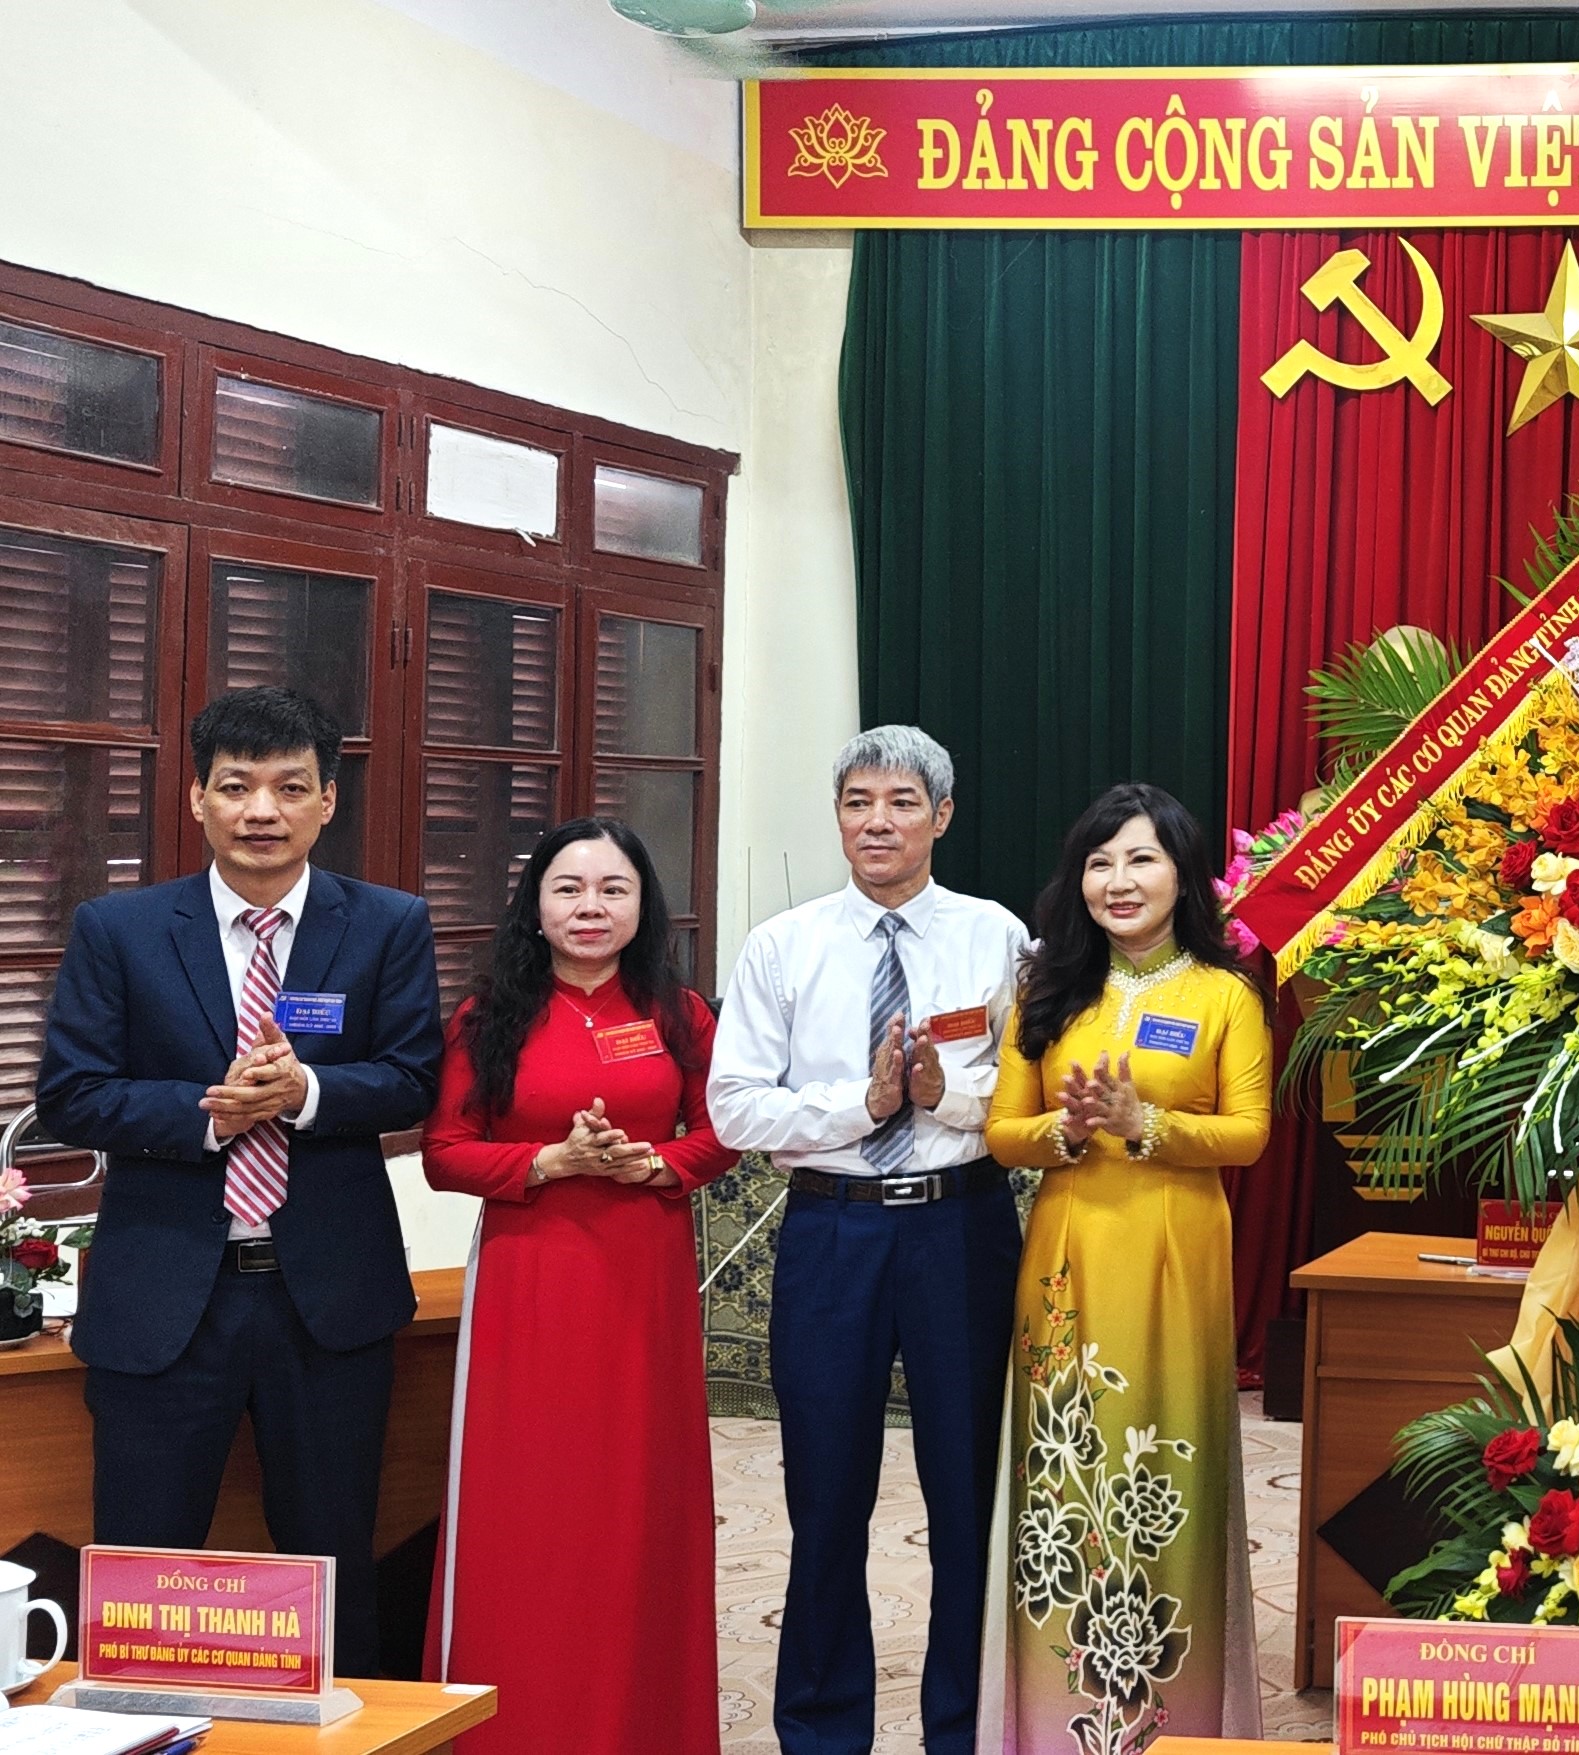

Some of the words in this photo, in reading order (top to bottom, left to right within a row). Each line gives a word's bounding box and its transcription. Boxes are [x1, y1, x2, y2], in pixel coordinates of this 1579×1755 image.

[917, 88, 1099, 192] ĐẢNG
[1115, 94, 1292, 210] CỘNG
[1309, 84, 1439, 191] SẢN
[1294, 828, 1355, 891] ĐẢNG
[1349, 796, 1383, 837] ỦY
[1376, 765, 1418, 806] CÁC
[1411, 735, 1442, 775] CƠ
[1437, 693, 1493, 750] QUAN
[1484, 640, 1541, 700] ĐẢNG
[1485, 1221, 1529, 1242] NGUYỄN
[1531, 1225, 1553, 1244] QUỐ
[157, 1569, 209, 1592] ĐỒNG
[214, 1574, 247, 1594] CHÍ
[102, 1601, 153, 1631] ĐINH
[159, 1604, 191, 1638] THỊ
[197, 1606, 266, 1637] THANH
[271, 1606, 301, 1639] HÀ
[99, 1641, 117, 1659] PHÓ
[119, 1643, 129, 1660] BÍ
[131, 1645, 150, 1661] THƯ
[151, 1641, 175, 1662] ĐẢNG
[177, 1642, 189, 1663] ỦY
[191, 1646, 209, 1664] CÁC
[212, 1649, 224, 1665] CƠ
[226, 1652, 251, 1667] QUAN
[252, 1647, 277, 1668] ĐẢNG
[280, 1649, 301, 1669] TỈNH
[1420, 1638, 1487, 1663] ĐỒNG
[1494, 1641, 1536, 1665] CHÍ
[1362, 1676, 1434, 1728] PHẠM
[1443, 1673, 1510, 1722] HÙNG
[1361, 1730, 1387, 1745] PHÓ
[1390, 1730, 1416, 1748] CHỦ
[1420, 1733, 1448, 1749] TỊCH
[1452, 1733, 1474, 1752] HỘI
[1477, 1734, 1504, 1749] CHỮ
[1507, 1734, 1540, 1752] THẬP
[1543, 1733, 1560, 1751] ĐỎ
